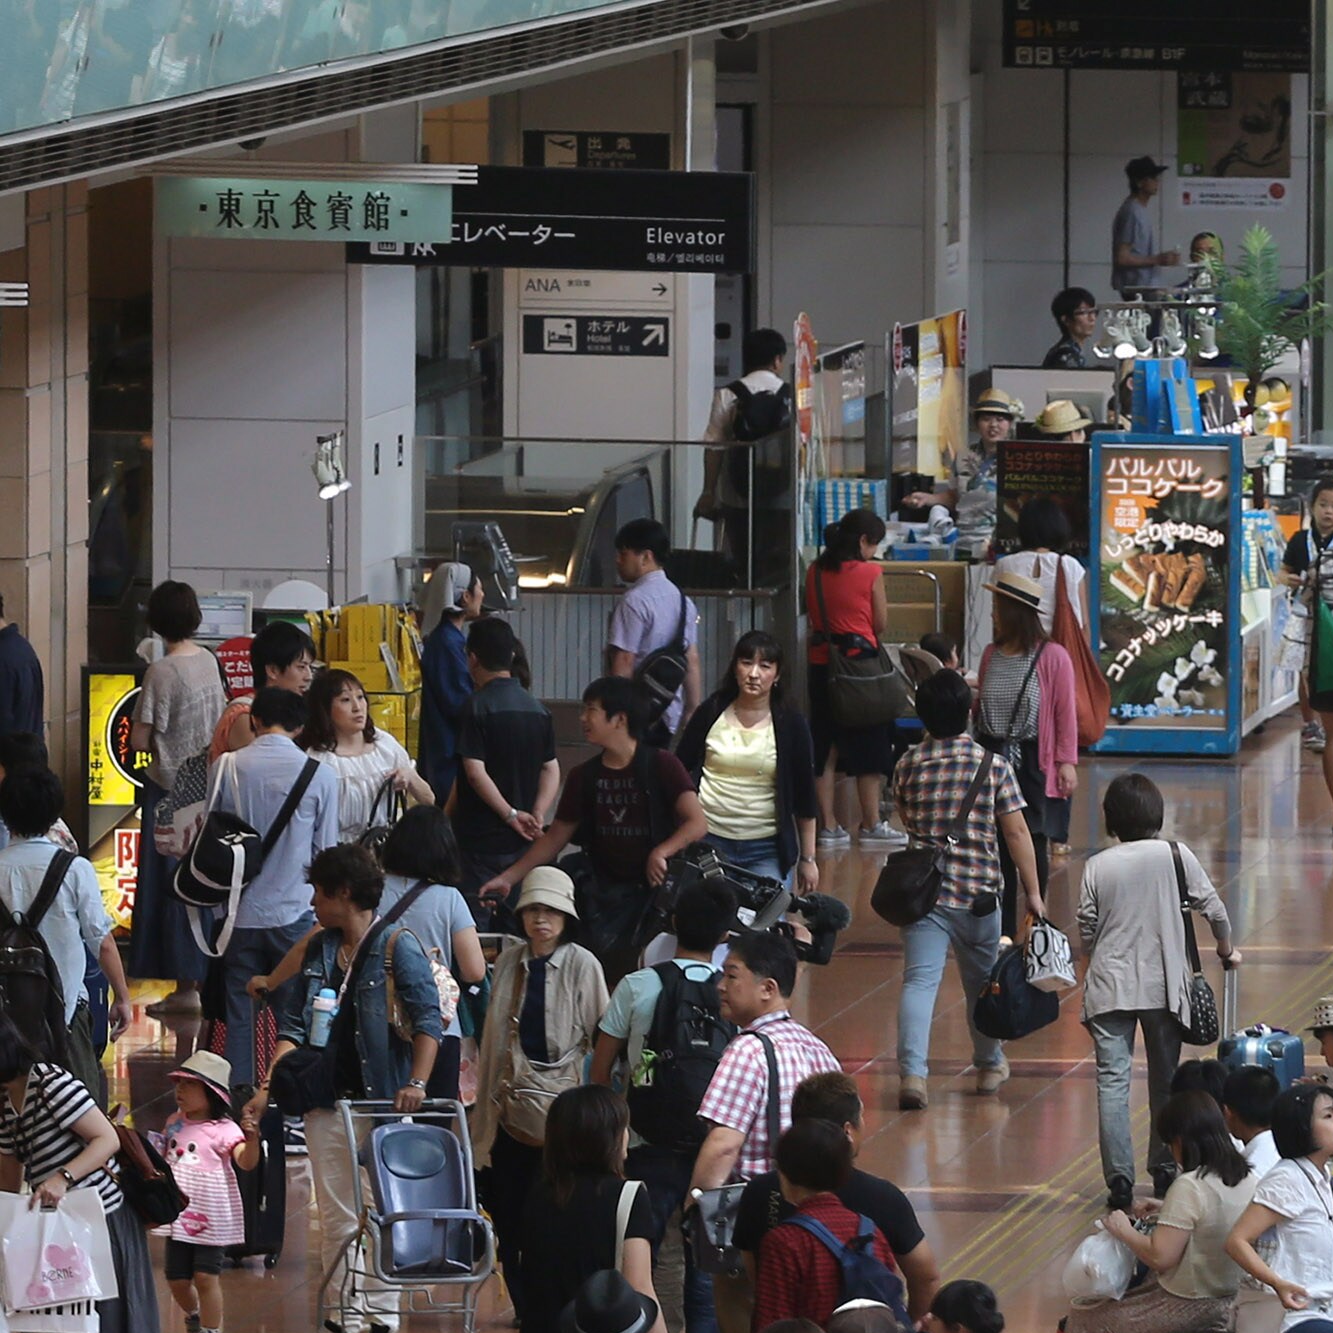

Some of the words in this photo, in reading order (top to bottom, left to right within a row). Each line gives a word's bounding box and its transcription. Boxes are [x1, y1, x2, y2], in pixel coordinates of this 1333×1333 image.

[216, 188, 391, 232] 東京食賓館
[646, 227, 725, 245] Elevator
[524, 278, 561, 292] ANA
[587, 320, 631, 334] ホテル
[587, 335, 612, 345] Hotel
[1106, 457, 1201, 478] パルパル
[1106, 477, 1224, 499] ココケーク
[1105, 519, 1225, 558] しっとりやわらか
[1106, 609, 1223, 682] ココナッツケーキ
